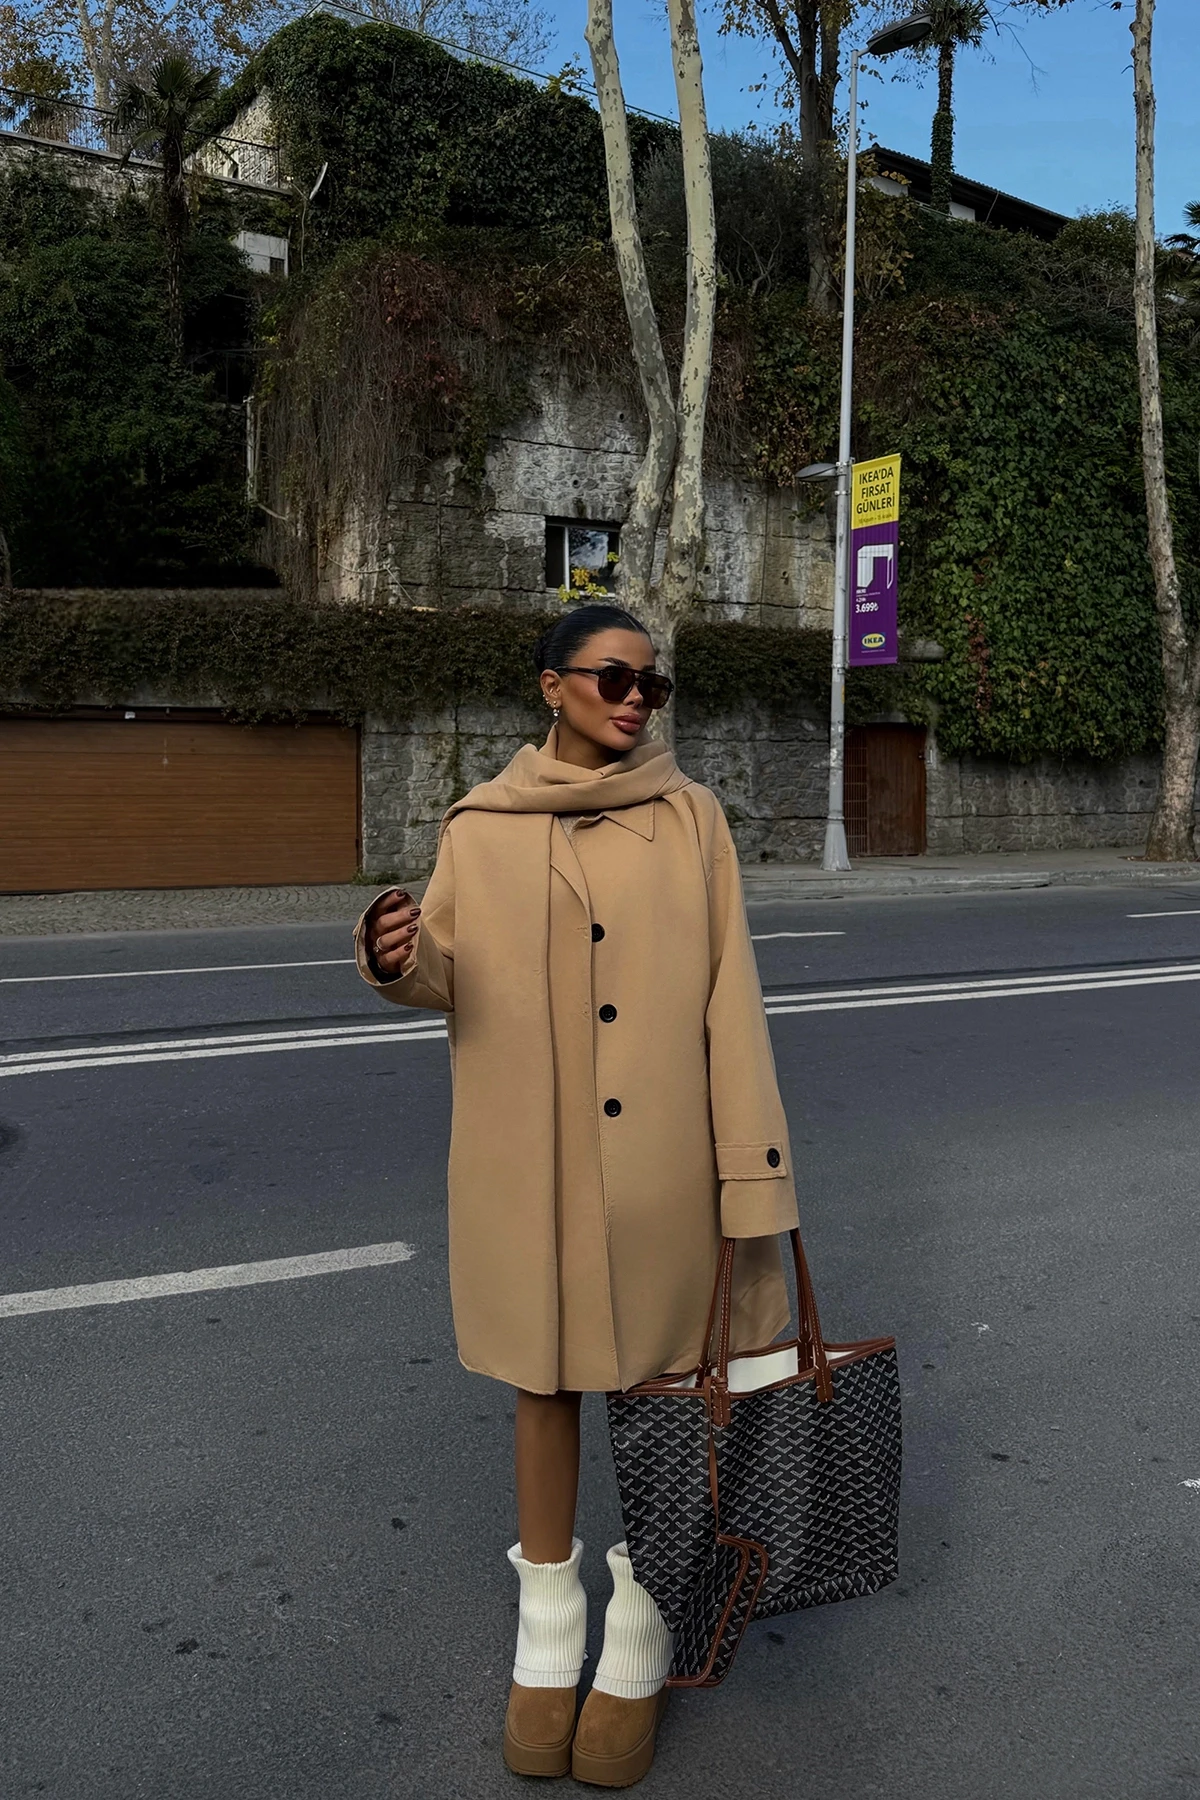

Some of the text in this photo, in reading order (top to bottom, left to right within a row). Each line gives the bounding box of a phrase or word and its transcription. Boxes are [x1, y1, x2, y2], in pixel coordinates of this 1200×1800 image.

[859, 467, 894, 485] IKEA'DA
[861, 482, 891, 499] FIRSAT
[856, 493, 895, 514] GÜNLERİ
